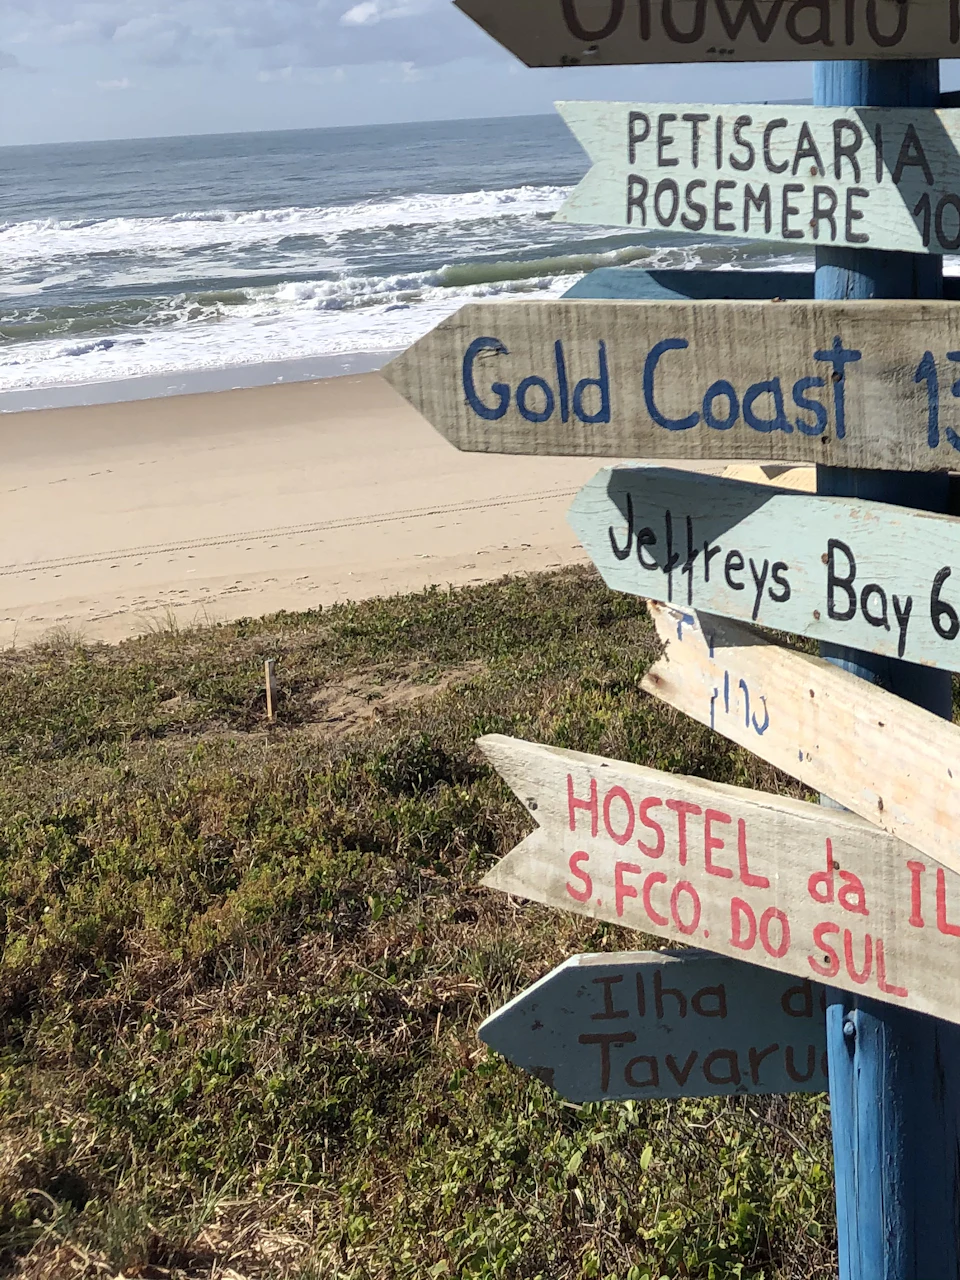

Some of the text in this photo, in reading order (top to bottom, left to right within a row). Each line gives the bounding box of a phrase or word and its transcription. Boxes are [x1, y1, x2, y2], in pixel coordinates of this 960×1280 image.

[628, 111, 934, 186] PETISCARIA
[627, 174, 870, 244] ROSEMERE
[462, 336, 611, 424] Gold
[643, 335, 862, 439] Coast
[608, 491, 792, 621] Jeffreys
[826, 538, 913, 658] Bay
[566, 773, 770, 888] HOSTEL
[807, 837, 870, 916] da
[729, 896, 791, 959] DO
[807, 921, 909, 997] SUL
[589, 969, 827, 1021] Ilha d
[577, 1030, 829, 1093] Tavaru
